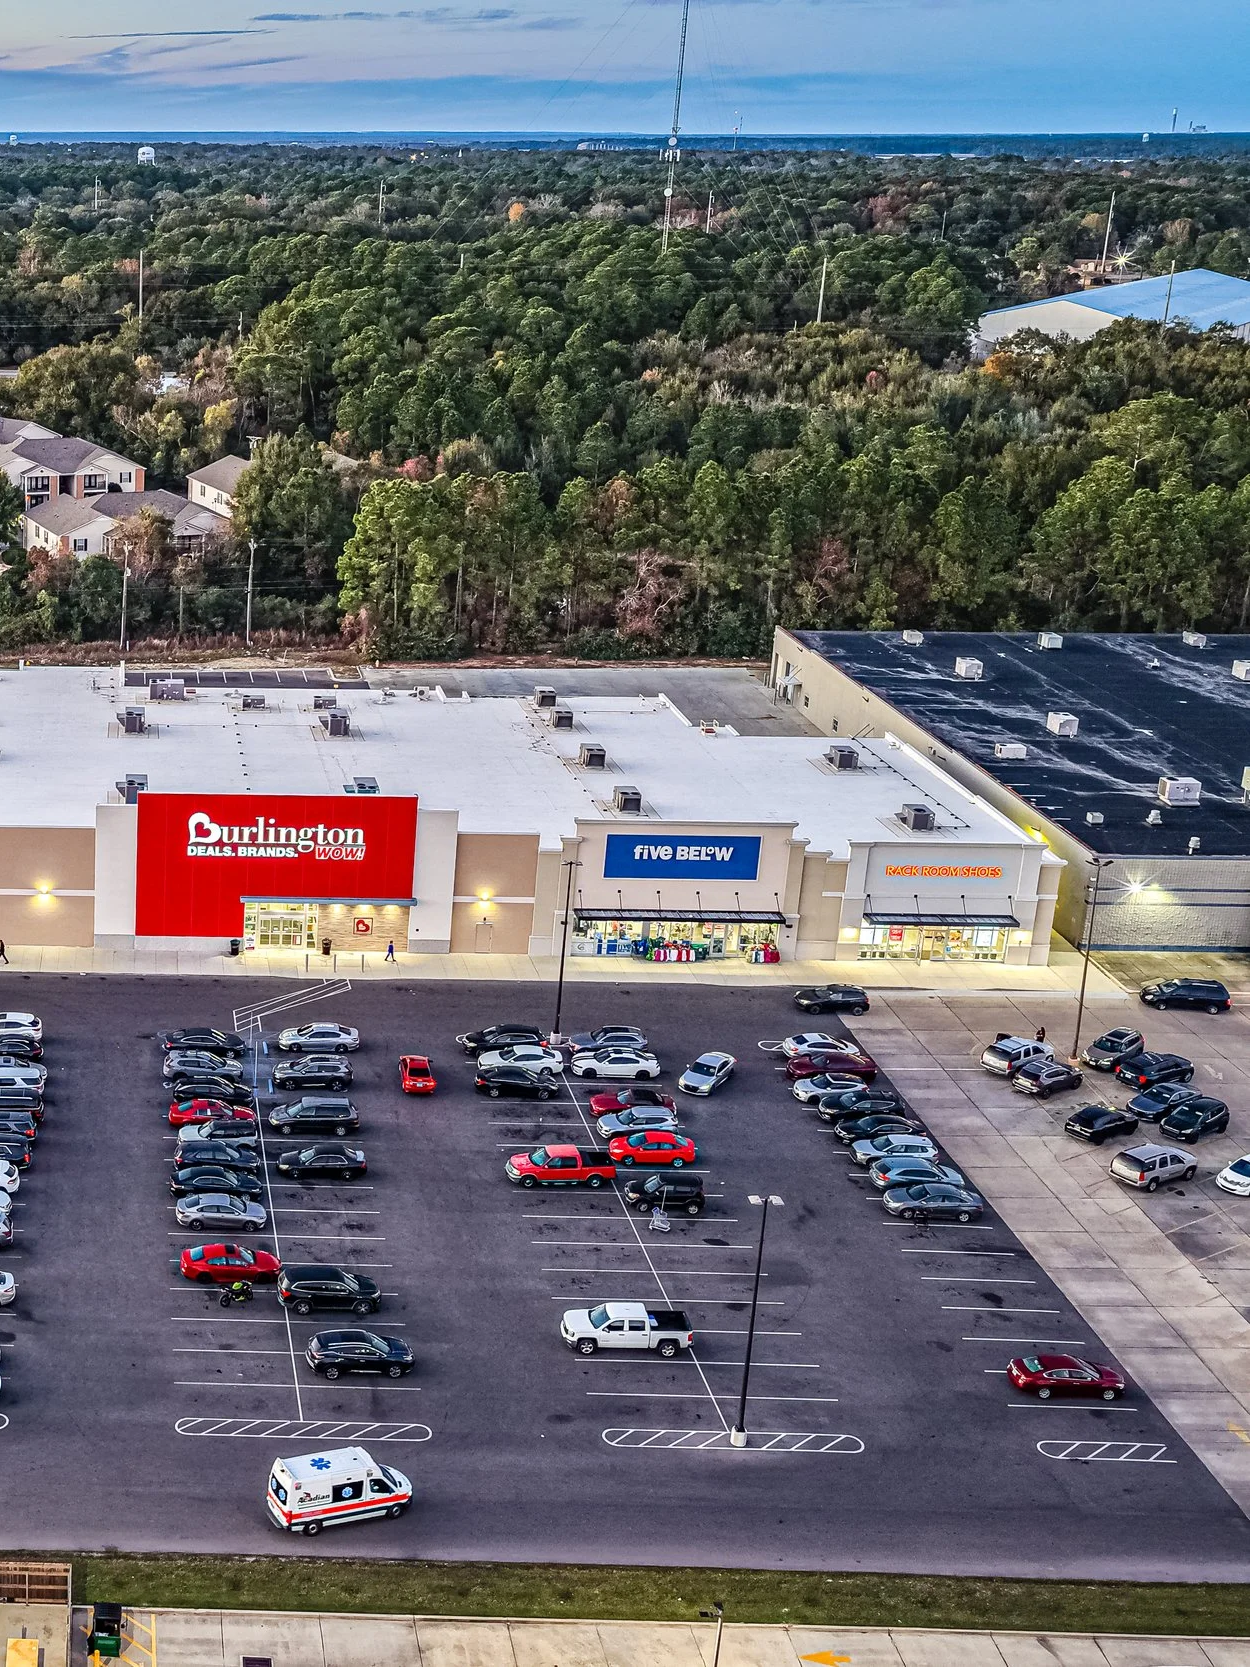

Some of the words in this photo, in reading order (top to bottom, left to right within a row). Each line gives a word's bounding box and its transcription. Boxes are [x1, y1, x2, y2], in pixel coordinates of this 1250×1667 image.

[188, 812, 365, 852] Burlington
[187, 846, 236, 857] DEALS.
[237, 846, 298, 857] BRANDS.
[316, 846, 366, 860] WOW!
[885, 865, 919, 876] RACK
[921, 866, 960, 877] ROOM
[961, 866, 1002, 878] SHOES
